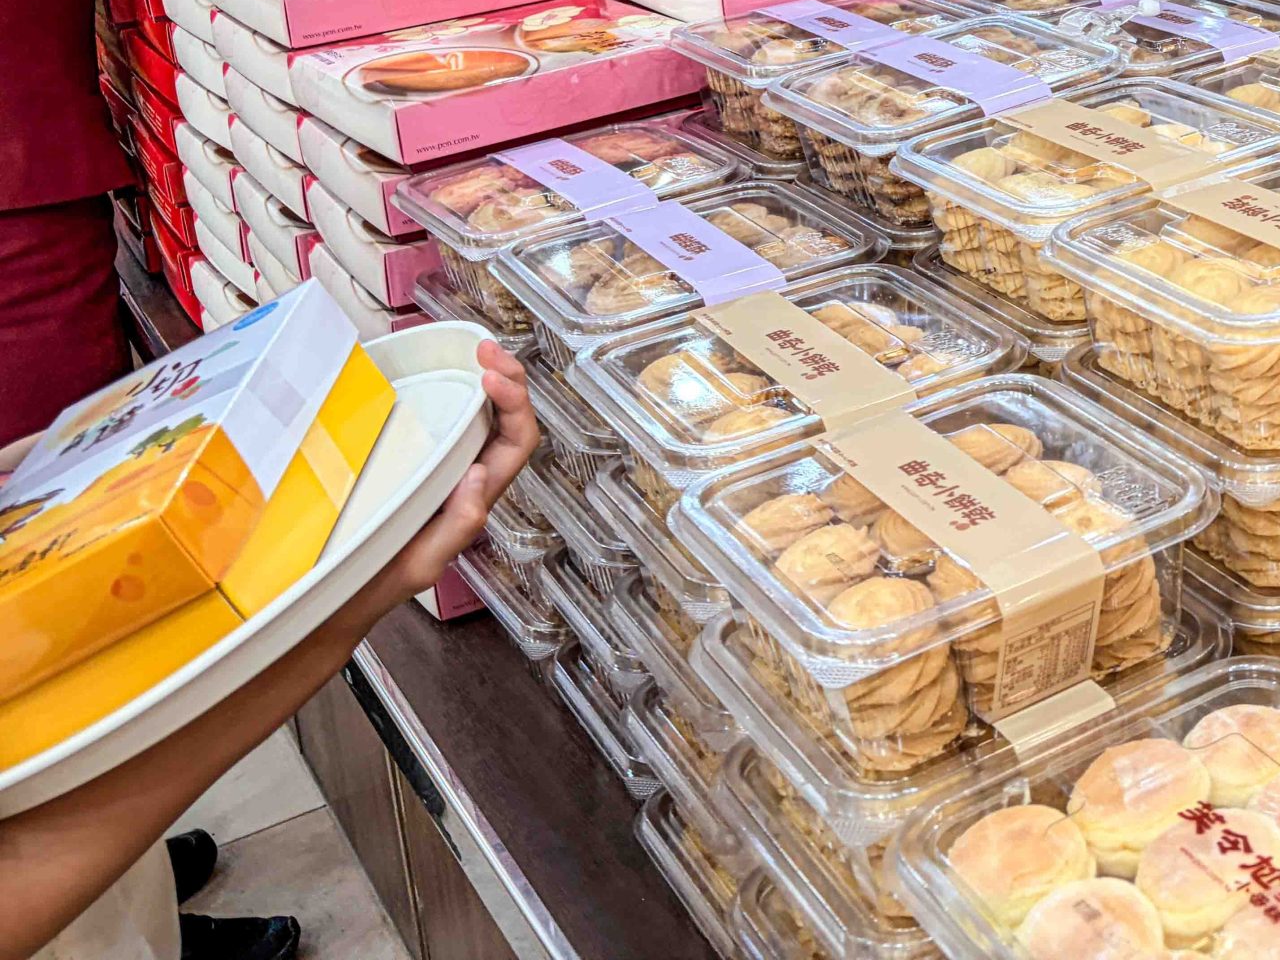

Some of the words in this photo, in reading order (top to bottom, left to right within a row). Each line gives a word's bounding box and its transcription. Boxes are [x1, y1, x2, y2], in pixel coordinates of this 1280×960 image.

[1065, 121, 1145, 153] 曲奇小餅乾
[765, 329, 840, 376] 曲奇小餅乾
[898, 460, 996, 526] 曲奇小餅乾
